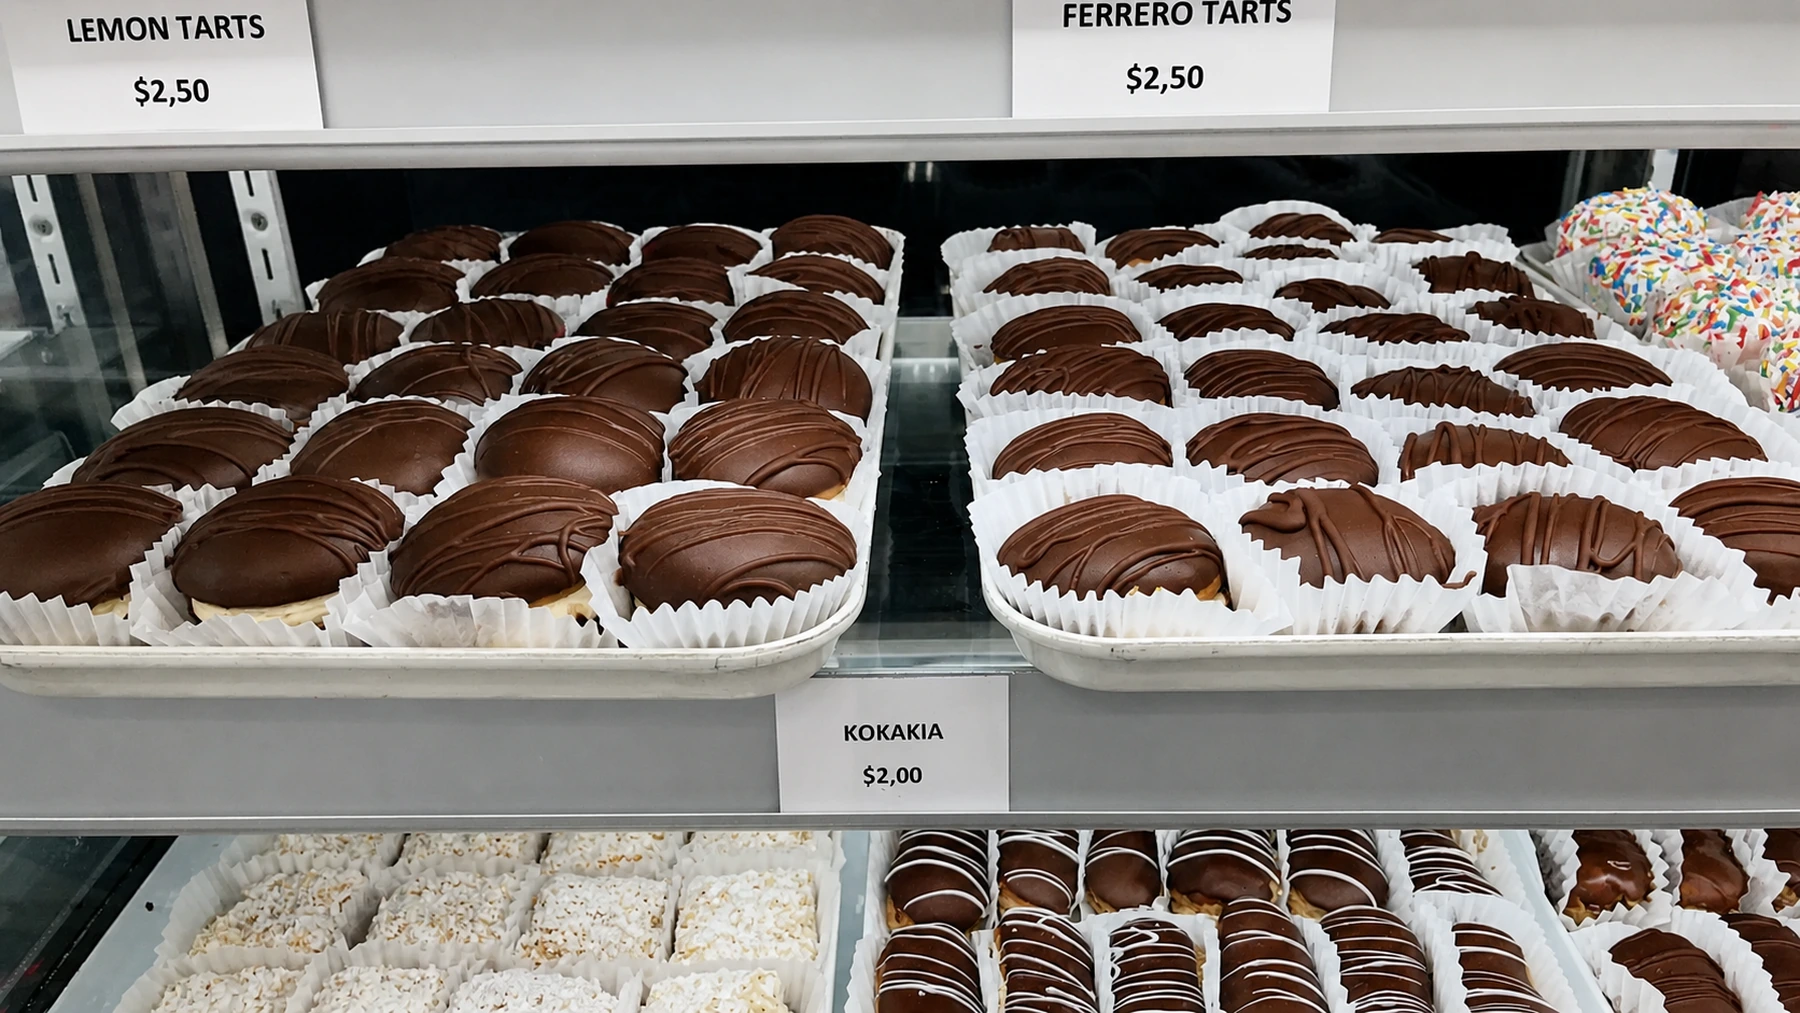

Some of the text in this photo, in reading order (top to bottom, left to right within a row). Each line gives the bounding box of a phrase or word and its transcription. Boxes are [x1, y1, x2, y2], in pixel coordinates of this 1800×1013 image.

[1063, 0, 1292, 27] FERRERO TARTS
[66, 14, 265, 42] LEMON TARTS
[133, 75, 210, 108] $2,50
[1126, 62, 1205, 94] $2,50
[843, 722, 944, 742] KOKAKIA
[862, 764, 923, 788] $2,00
